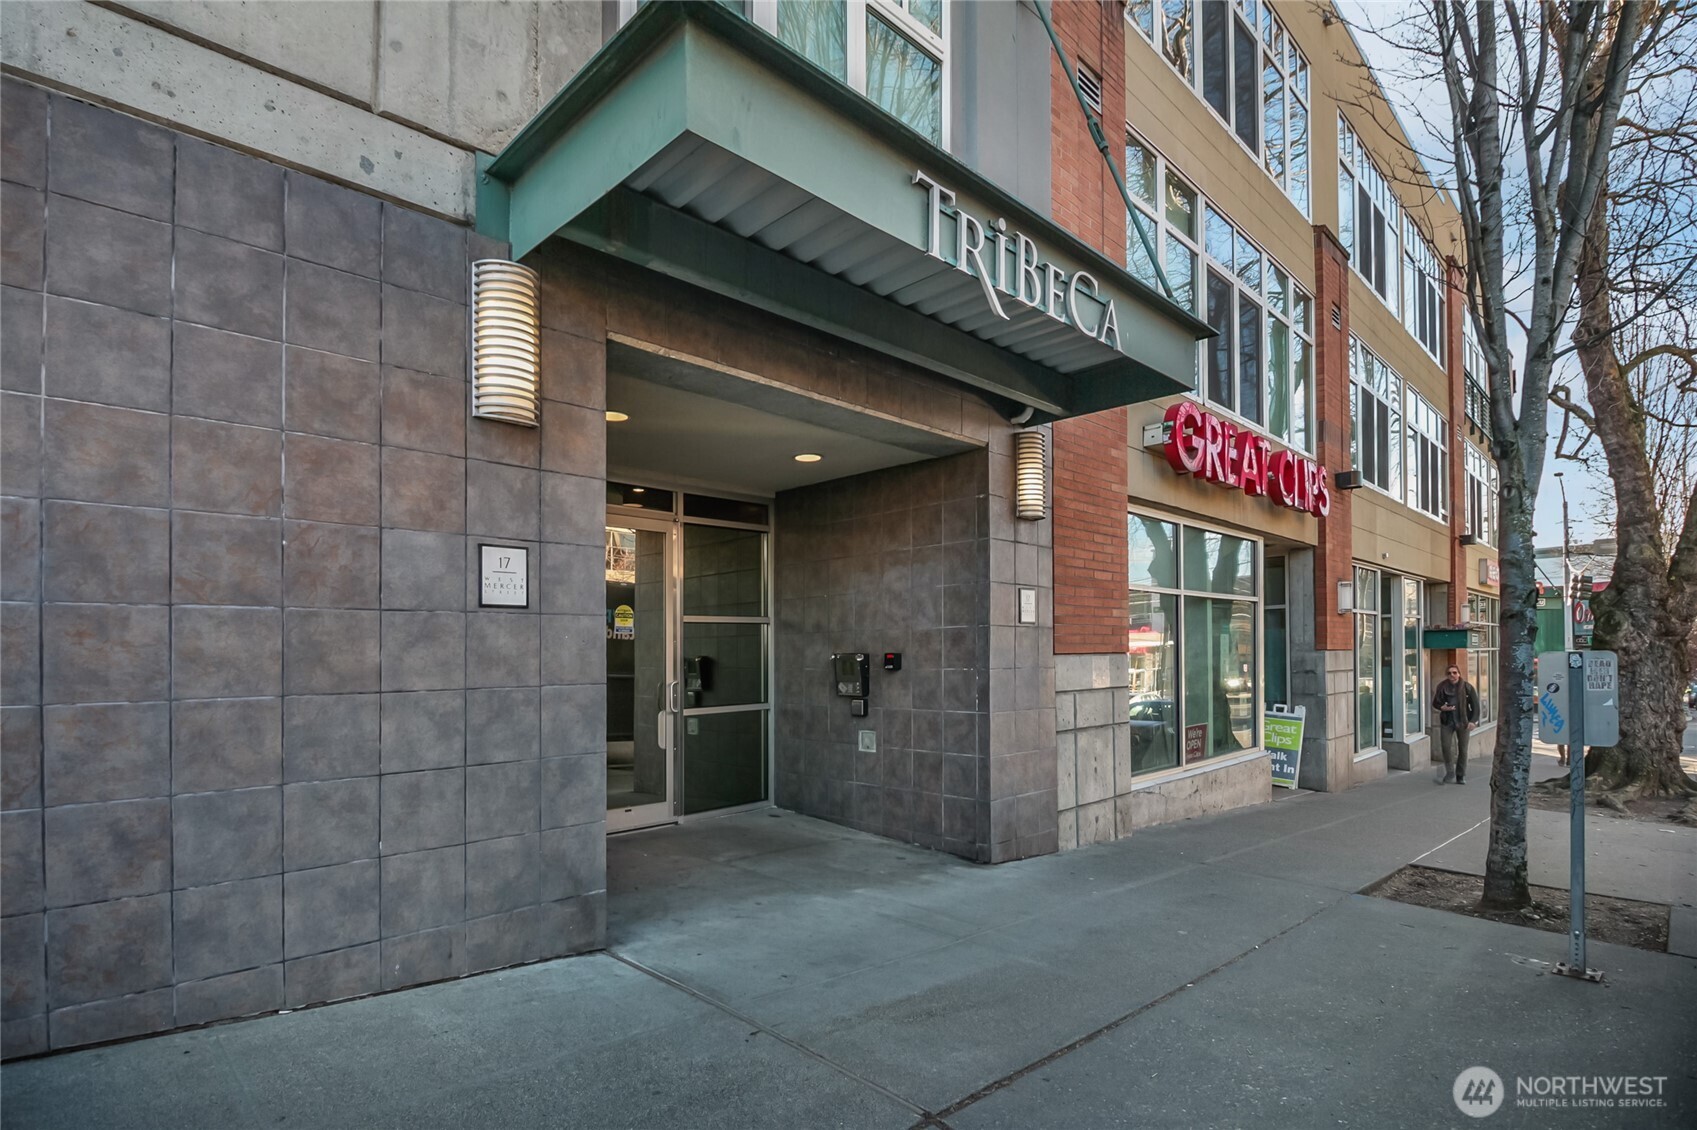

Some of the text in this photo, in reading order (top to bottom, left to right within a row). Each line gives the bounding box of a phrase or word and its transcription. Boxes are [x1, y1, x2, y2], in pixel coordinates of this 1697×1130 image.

[1164, 401, 1330, 517] GREAT CLIPS
[499, 556, 511, 569] 17
[1186, 739, 1201, 750] OPEN
[1267, 750, 1288, 761] alk
[1283, 764, 1295, 774] In
